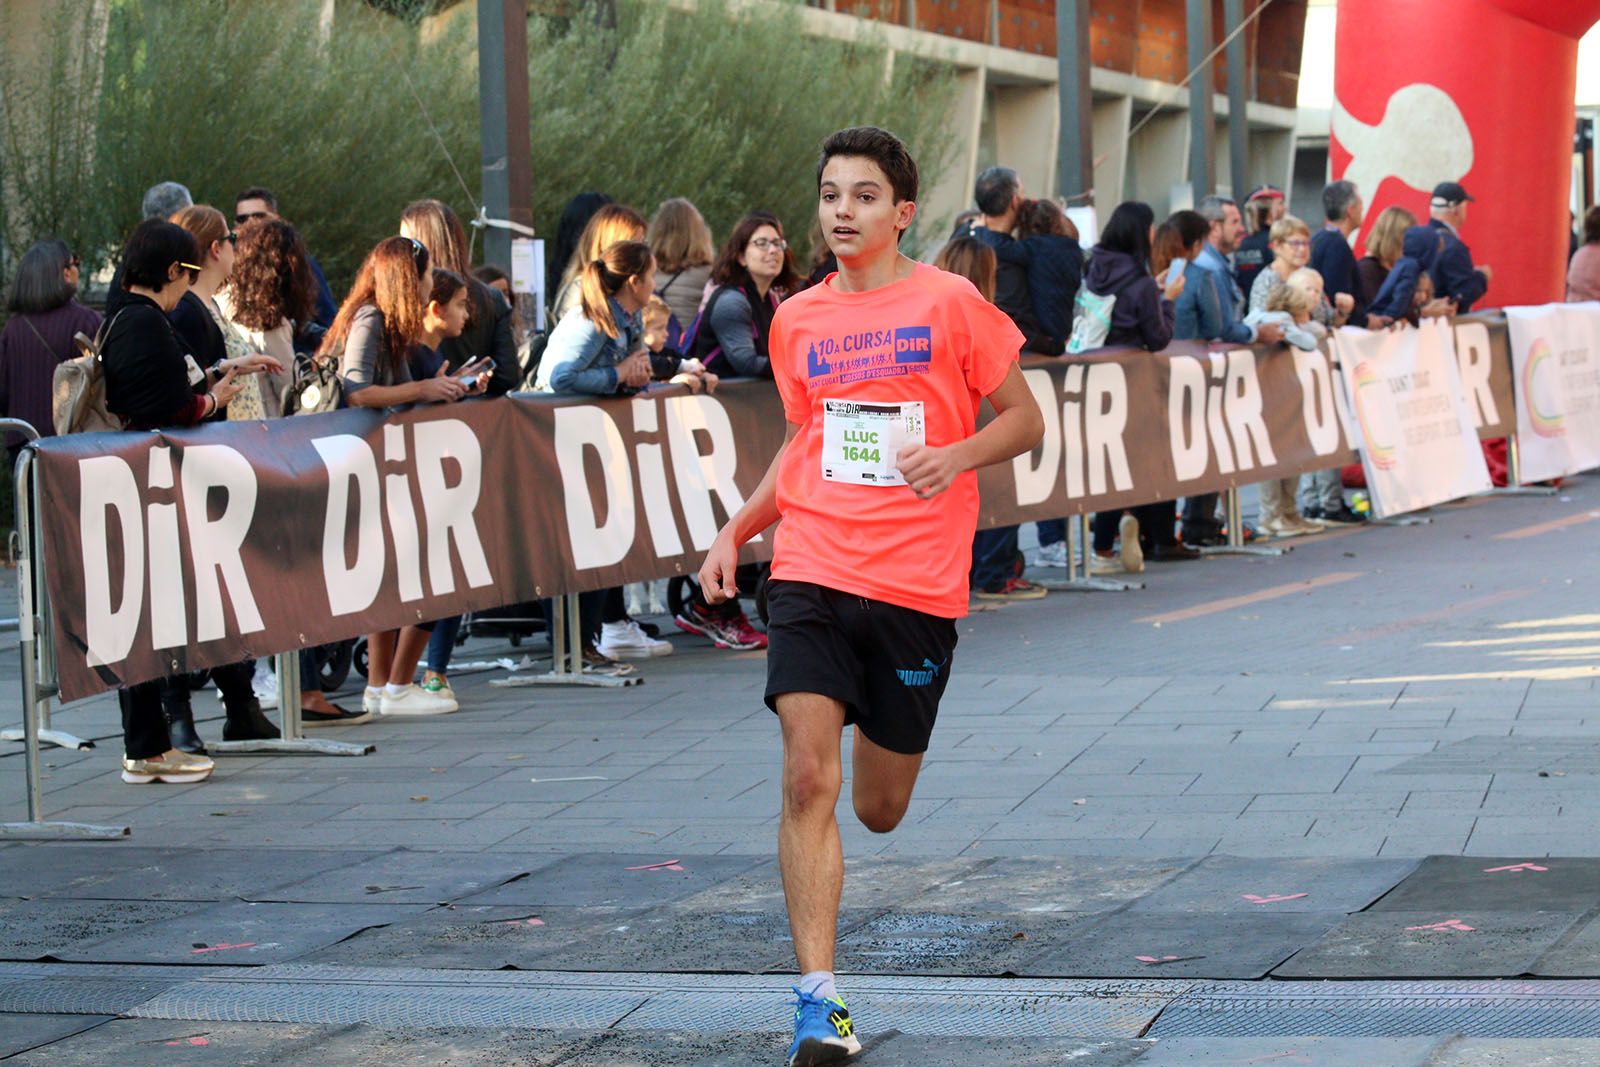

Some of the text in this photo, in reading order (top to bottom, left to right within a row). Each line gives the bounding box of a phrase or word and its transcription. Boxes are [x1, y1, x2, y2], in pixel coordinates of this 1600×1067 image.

[843, 330, 892, 352] CURSA
[842, 372, 866, 384] MOSSOS
[866, 366, 906, 377] D'ESQUADRA
[843, 430, 879, 444] LLUC
[842, 446, 881, 463] 1644
[896, 669, 934, 686] PUMA
